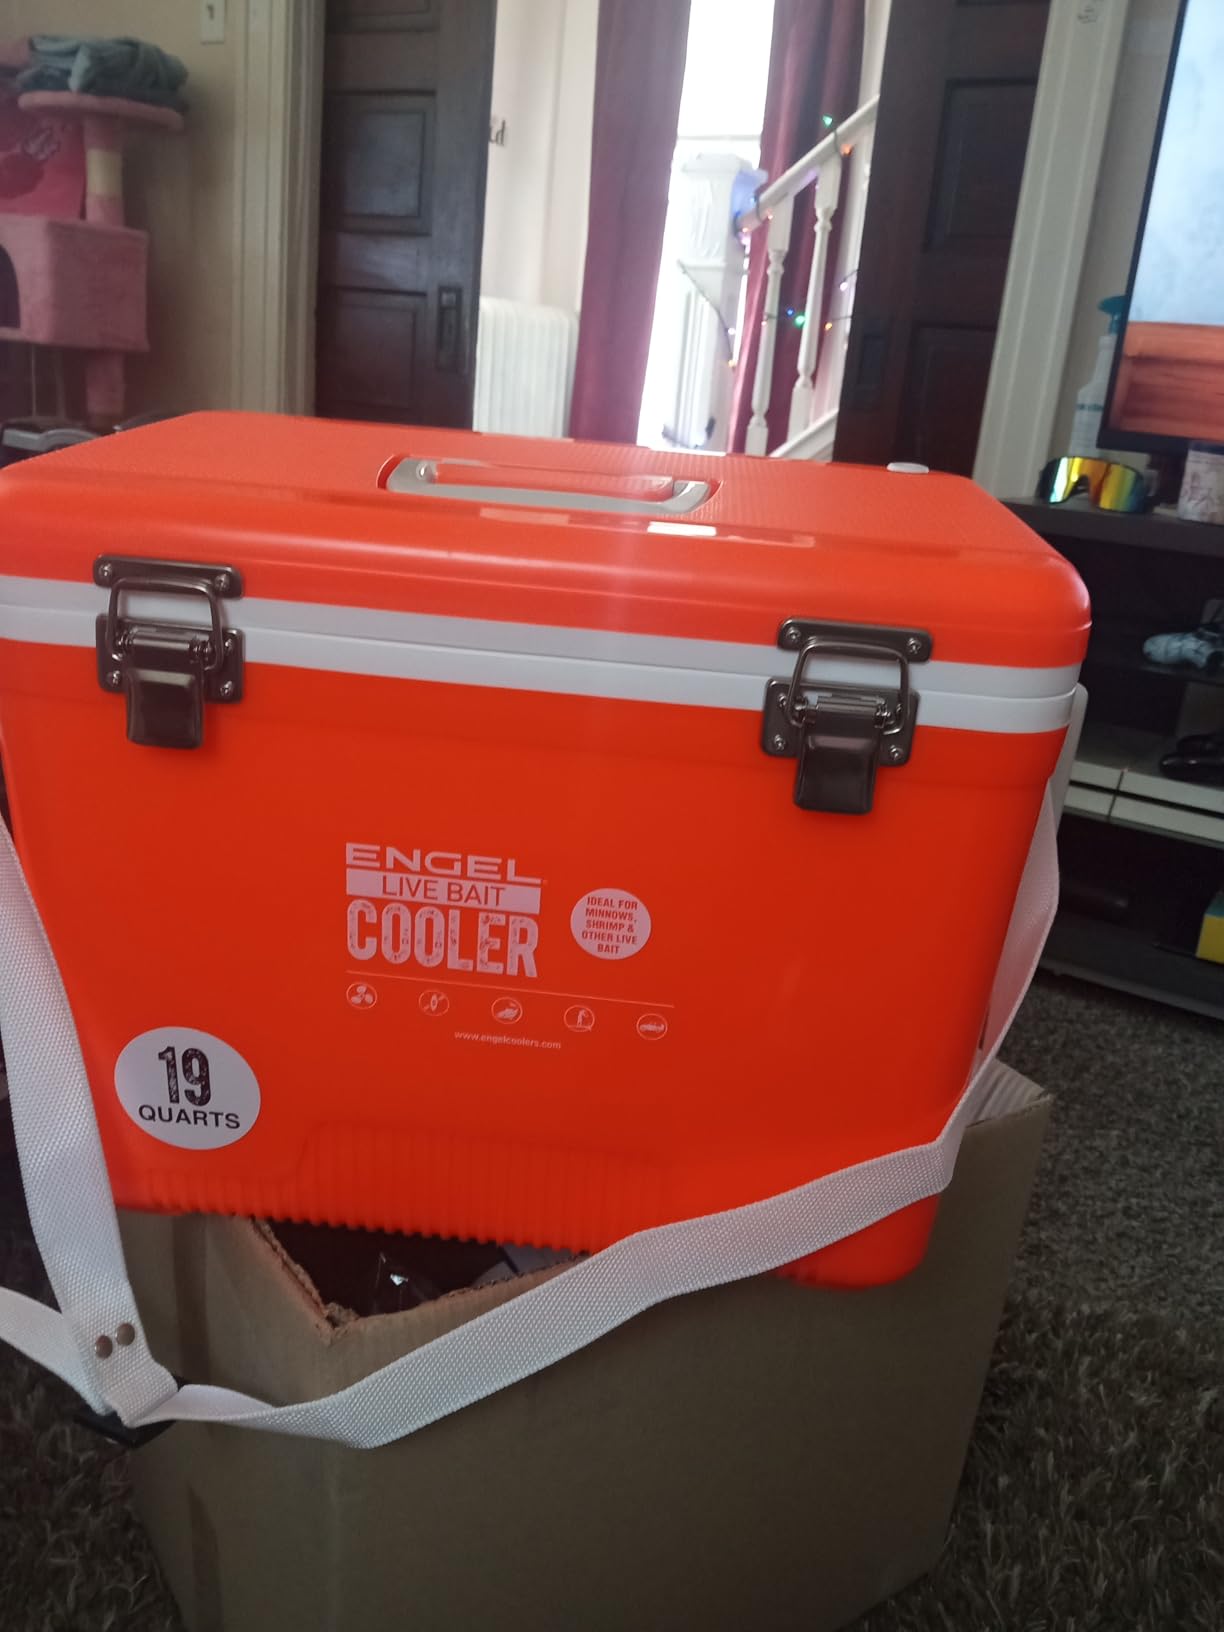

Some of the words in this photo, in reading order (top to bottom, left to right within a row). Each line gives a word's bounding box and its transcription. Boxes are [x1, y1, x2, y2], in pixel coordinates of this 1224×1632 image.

[345, 842, 542, 884] ENGEL
[382, 875, 438, 900] LIVE
[446, 881, 506, 907] BAIT
[587, 896, 614, 908] IDEAL
[618, 899, 638, 910] FOR
[585, 907, 637, 923] MINNOWS,
[585, 919, 625, 932] SHRIMP
[627, 924, 634, 933] &
[346, 899, 540, 978] COOLER
[581, 930, 614, 942] OTHER
[616, 934, 638, 945] LIVE
[597, 943, 620, 954] BAIT
[454, 1030, 561, 1050] www.engelcoolers.com
[158, 1046, 212, 1107] 19
[138, 1104, 241, 1130] QUARTS
